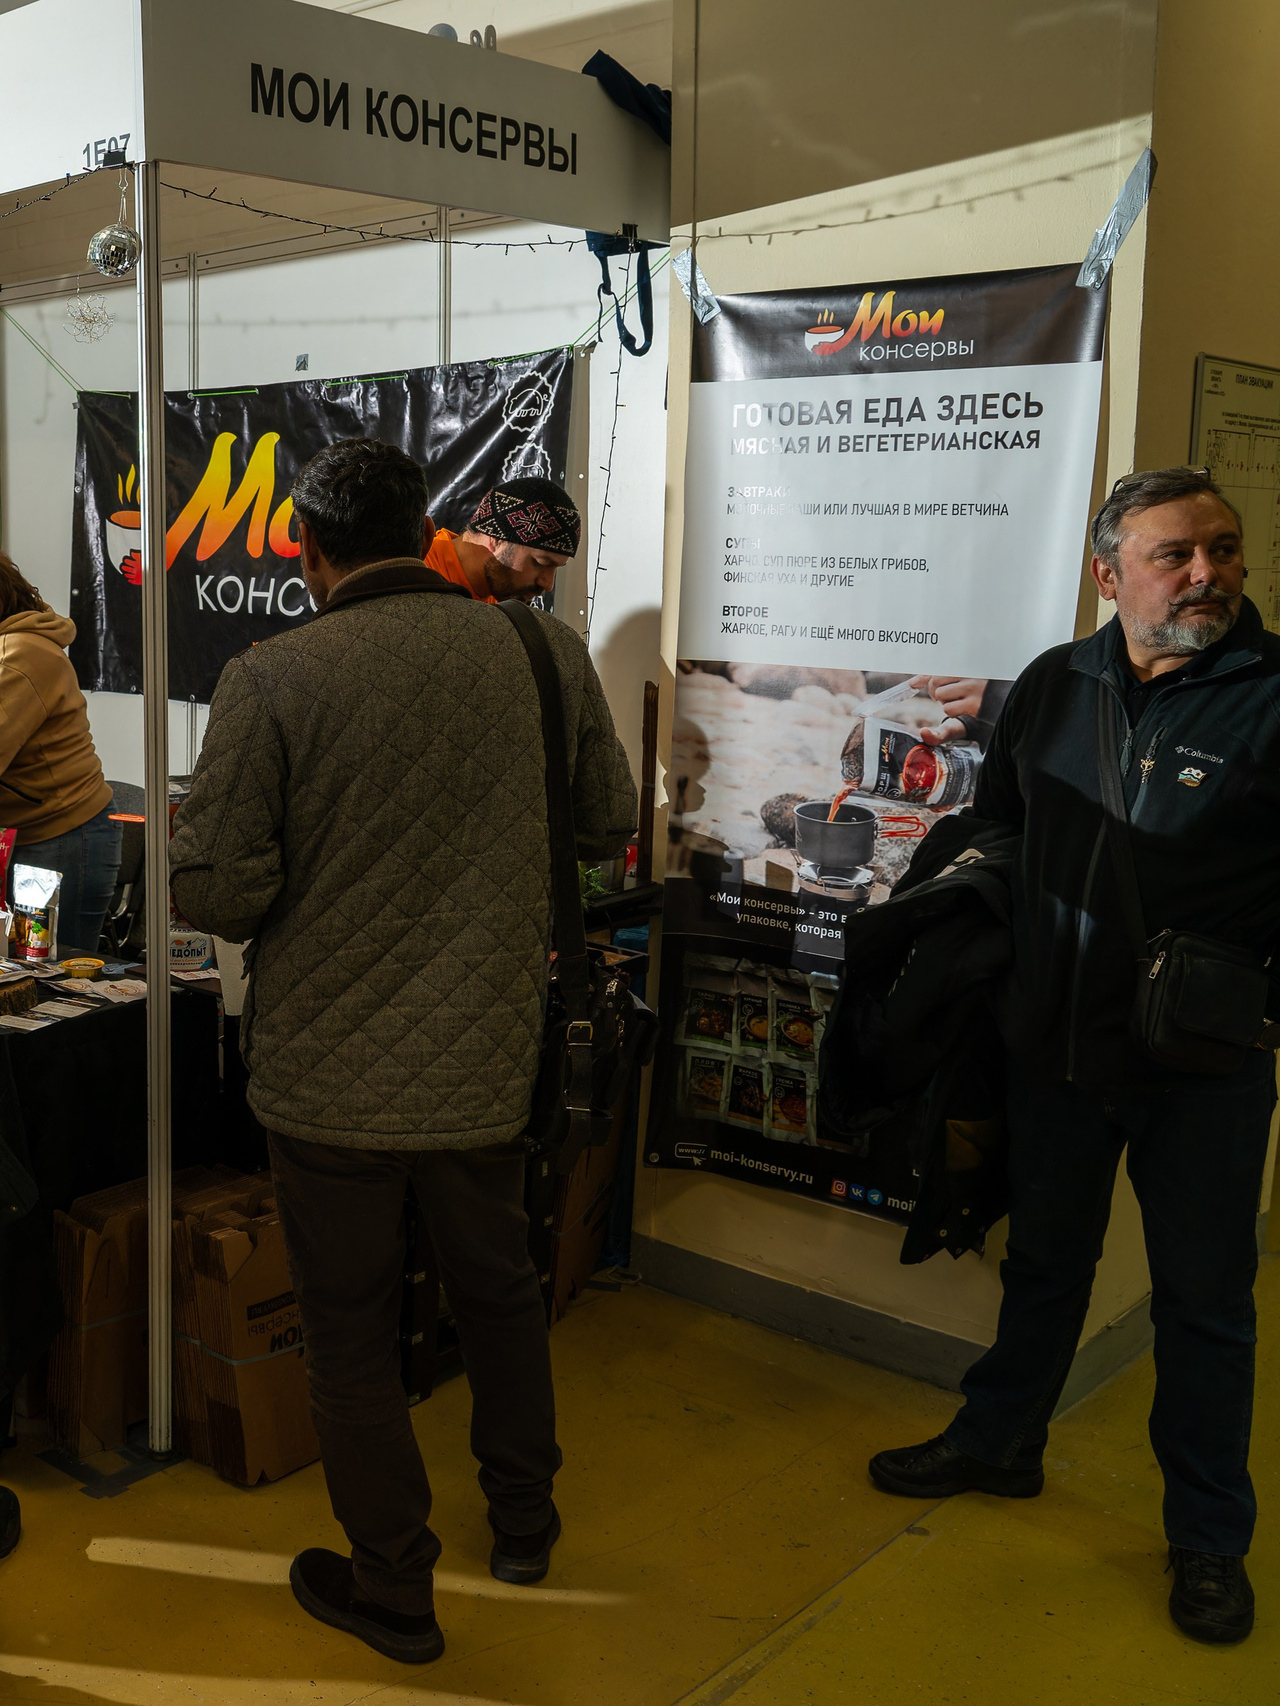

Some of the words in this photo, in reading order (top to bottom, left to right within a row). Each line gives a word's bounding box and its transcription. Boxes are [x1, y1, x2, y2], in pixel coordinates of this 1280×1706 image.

[250, 62, 349, 131] МОИ
[365, 87, 577, 175] КОНСЕРВЫ
[844, 290, 945, 343] Мои
[859, 339, 974, 362] консервы
[732, 399, 852, 428] ГОТОВАЯ
[863, 396, 927, 428] ЕДА
[936, 391, 1044, 426] ЗДЕСЬ
[730, 435, 810, 455] МЯСНАЯ
[816, 435, 831, 454] И
[837, 429, 1041, 454] ВЕГЕТЕРИАНСКАЯ
[165, 431, 302, 572] Мо
[788, 503, 821, 516] АШИ
[823, 503, 848, 516] ИЛИ
[850, 503, 900, 516] ЛУЧШАЯ
[903, 503, 911, 516] В
[914, 503, 948, 516] МИРЕ
[951, 502, 1009, 517] ВЕТЧИНА
[762, 555, 785, 567] СУП
[786, 555, 818, 568] ПЮРЕ
[820, 556, 836, 569] ИЗ
[838, 557, 878, 570] БЕЛЫХ
[880, 558, 930, 573] ГРИБОВ,
[777, 572, 798, 585] УХА
[800, 573, 808, 585] И
[810, 574, 855, 588] ДРУГИЕ
[721, 604, 770, 618] ВТОРОЕ
[720, 622, 768, 636] ЖАРКОЕ,
[770, 624, 798, 637] РАГУ
[799, 625, 808, 637] И
[810, 624, 835, 640] ЕЩЁ
[836, 627, 876, 642] МНОГО
[877, 629, 939, 645] ВКУСНОГО
[1184, 747, 1224, 765] Columbia
[709, 891, 741, 905] «Мои
[744, 897, 806, 916] консервы»
[817, 910, 838, 922] это
[736, 912, 792, 932] упаковке,
[795, 922, 842, 939] которая
[170, 947, 207, 958] ЕДОПЫТ
[710, 1148, 814, 1185] moi-konservy.ru
[247, 1310, 299, 1337] нсервы
